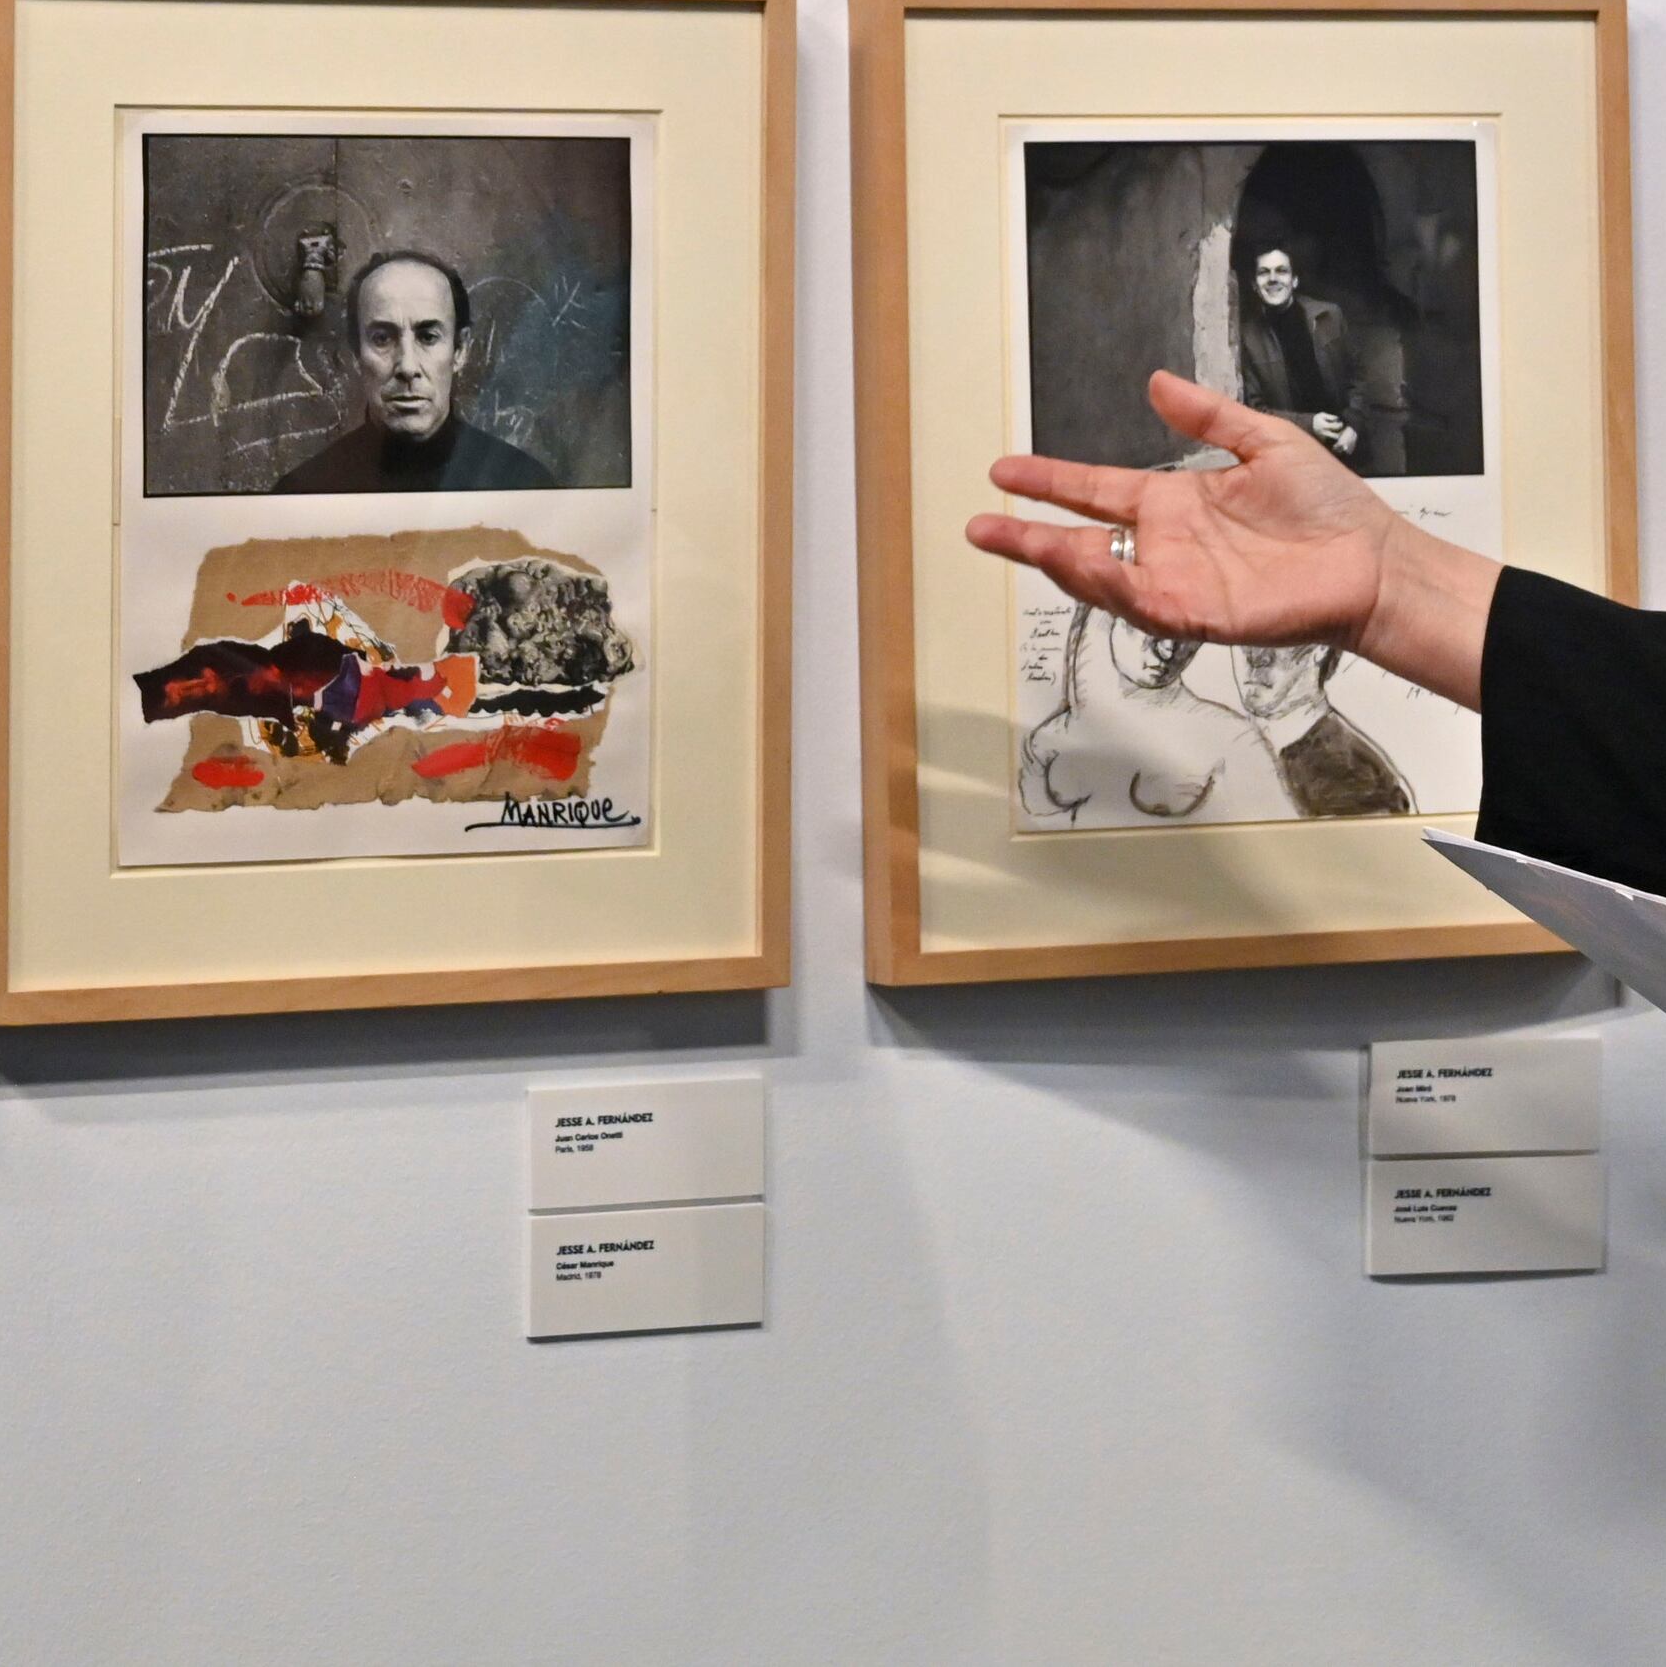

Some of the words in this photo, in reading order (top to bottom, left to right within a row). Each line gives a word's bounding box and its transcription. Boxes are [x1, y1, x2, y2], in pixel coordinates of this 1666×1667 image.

[555, 1117, 583, 1127] JESSE
[585, 1116, 595, 1126] A.
[597, 1112, 653, 1125] FERNÁNDEZ
[556, 1244, 584, 1255] JESSE
[586, 1244, 596, 1253] A.
[598, 1239, 655, 1253] FERNÁNDEZ
